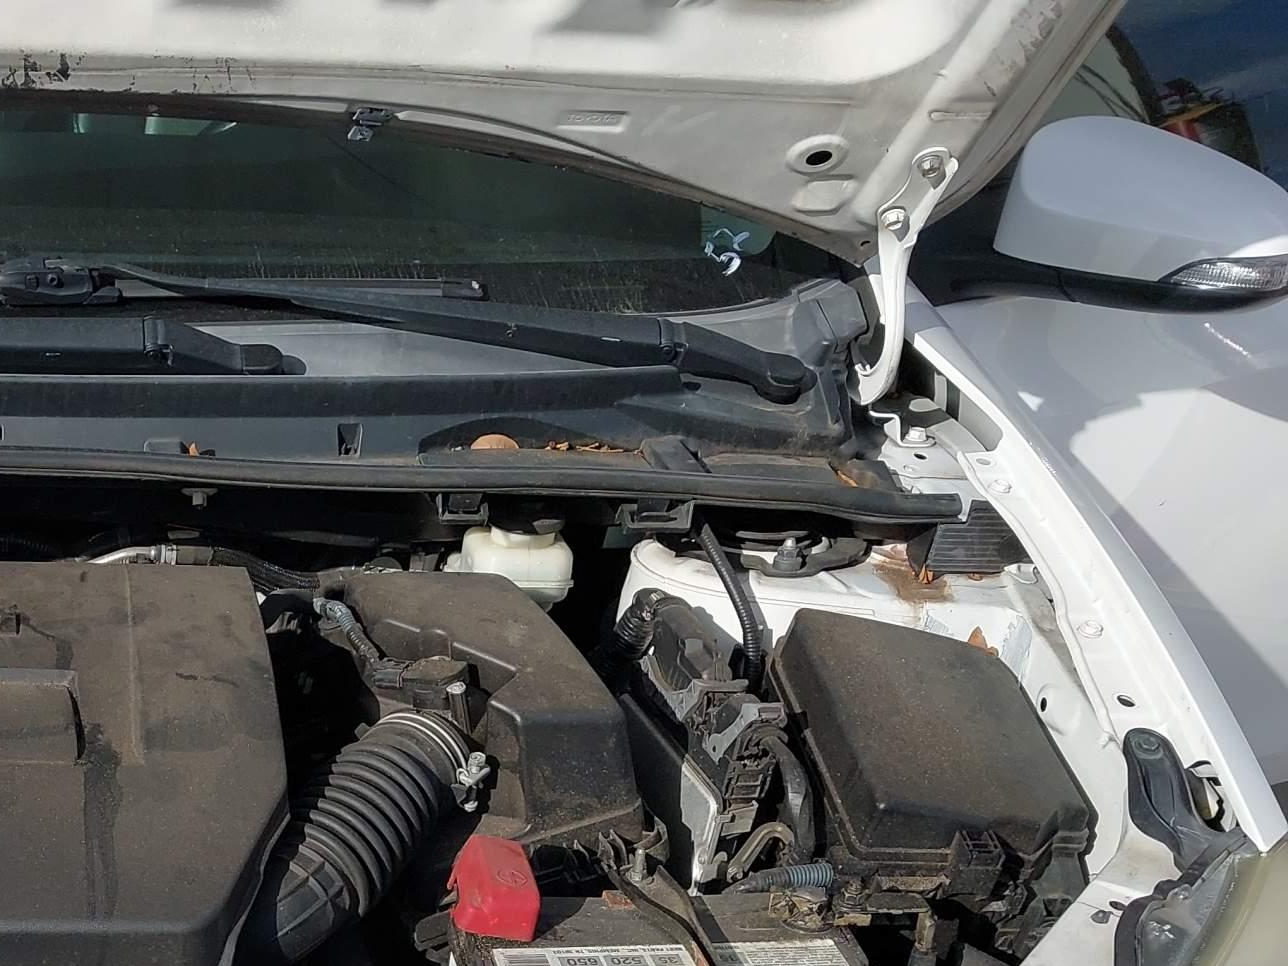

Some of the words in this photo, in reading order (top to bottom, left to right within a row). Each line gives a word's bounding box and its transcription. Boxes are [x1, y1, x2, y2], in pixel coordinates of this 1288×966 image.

[566, 957, 598, 966] 650
[611, 956, 642, 965] 520
[658, 956, 678, 964] 35
